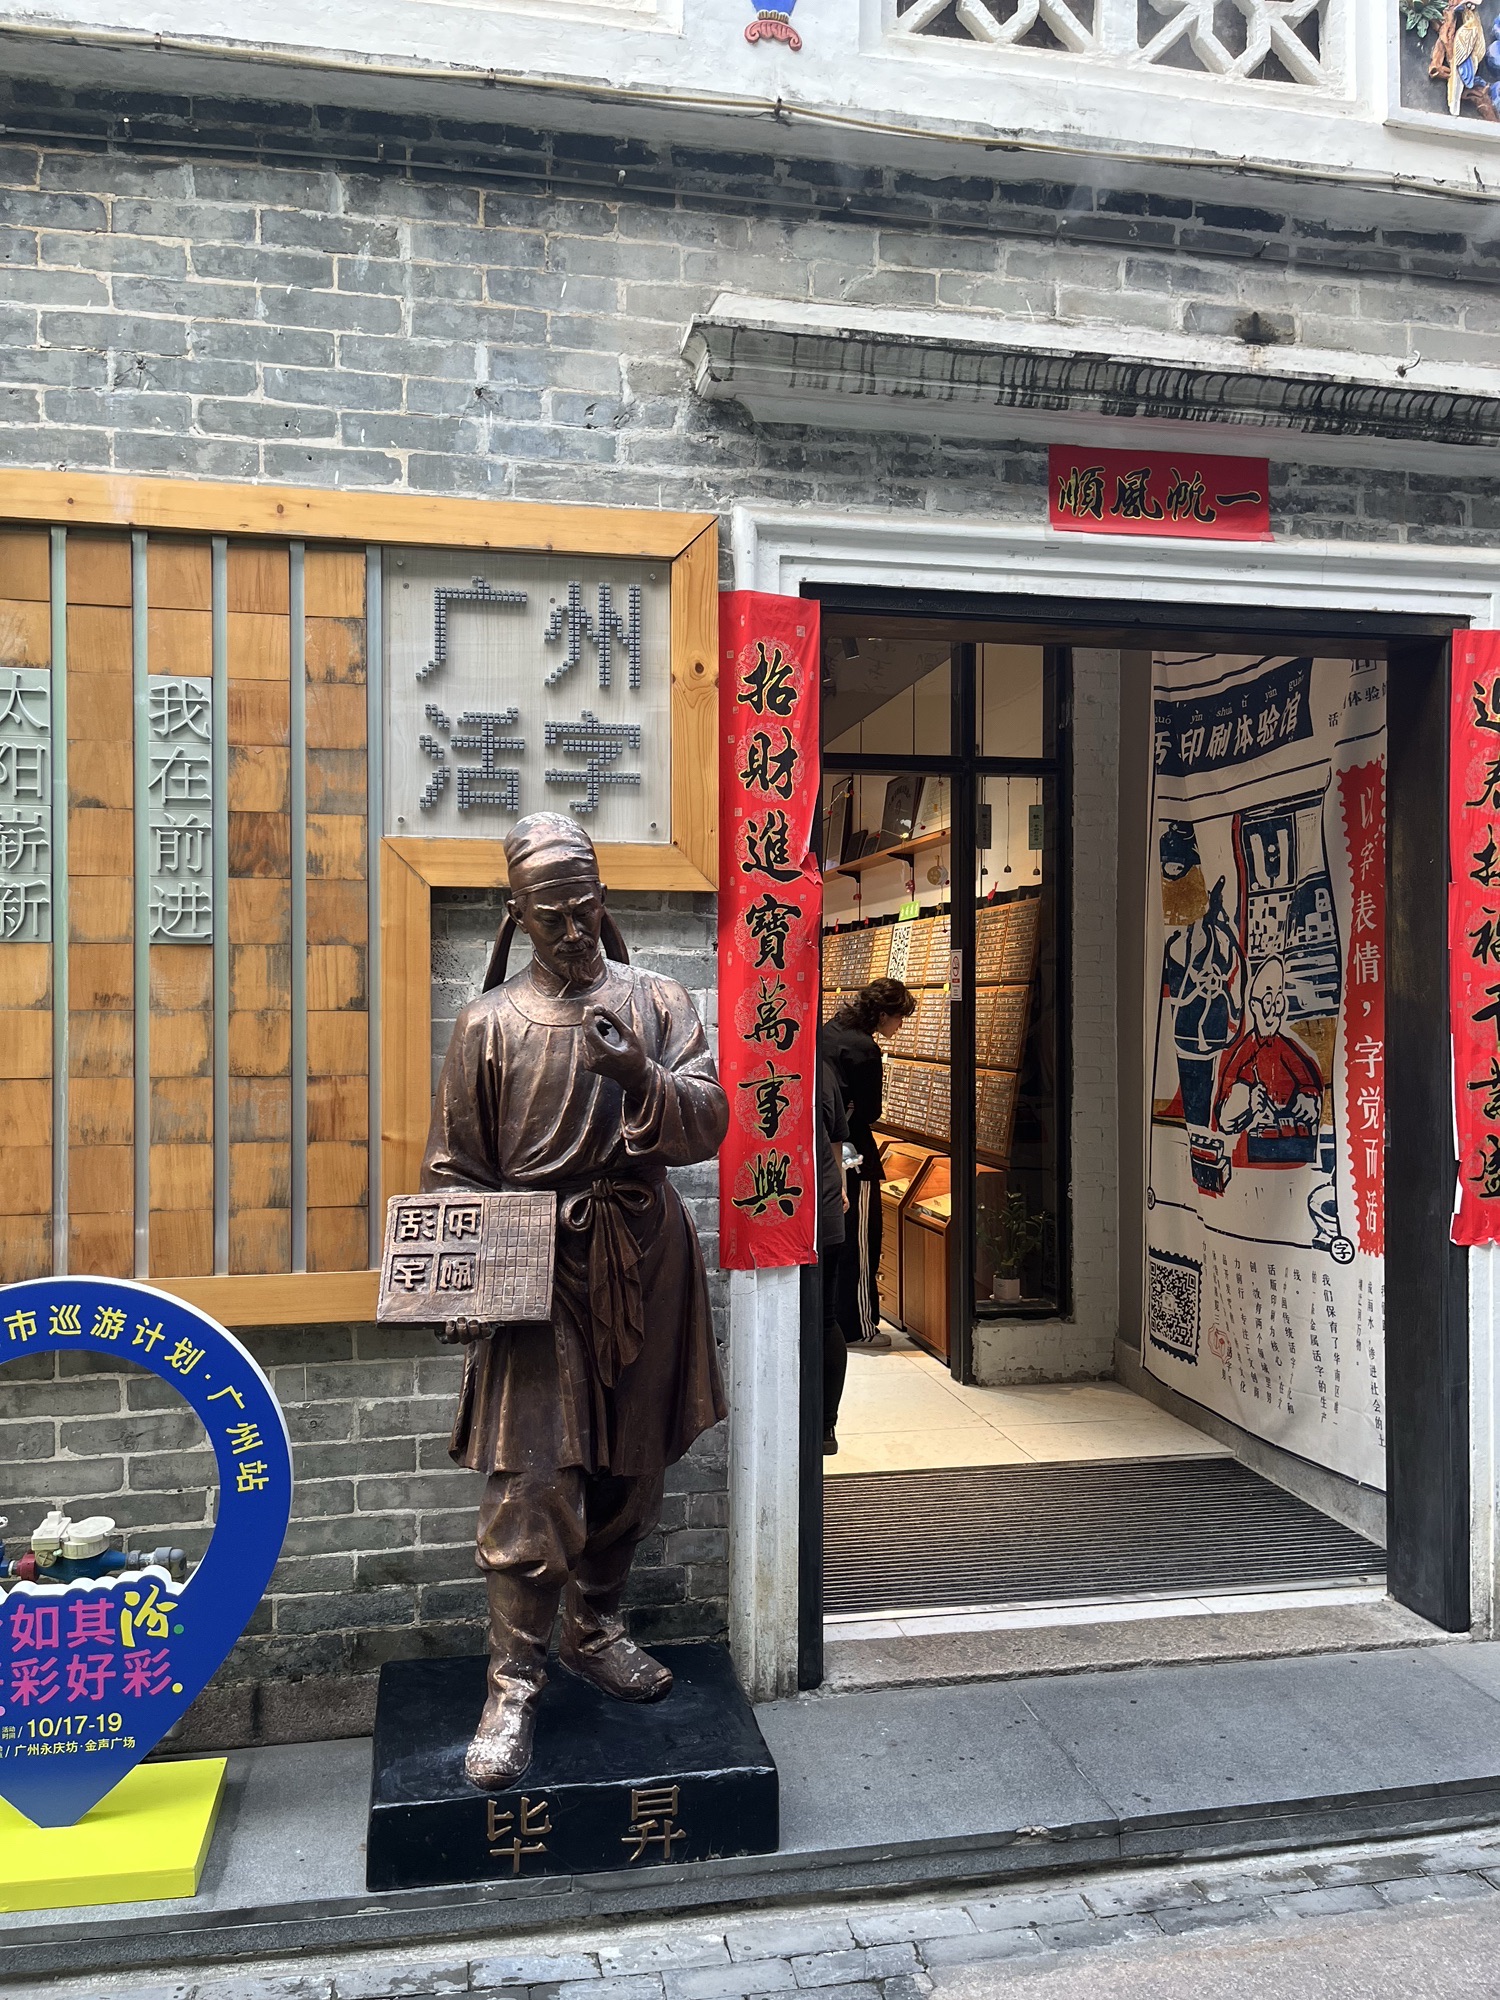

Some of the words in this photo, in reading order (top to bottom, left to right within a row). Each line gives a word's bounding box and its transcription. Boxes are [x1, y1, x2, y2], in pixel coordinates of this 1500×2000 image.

[415, 575, 641, 689] 广州
[419, 704, 641, 812] 活字
[148, 680, 211, 938] 我在前进
[1334, 1242, 1350, 1260] 字
[0, 1648, 172, 1706] 彩好彩
[27, 1713, 122, 1738] 10/17-19
[487, 1785, 687, 1874] 毕昇
